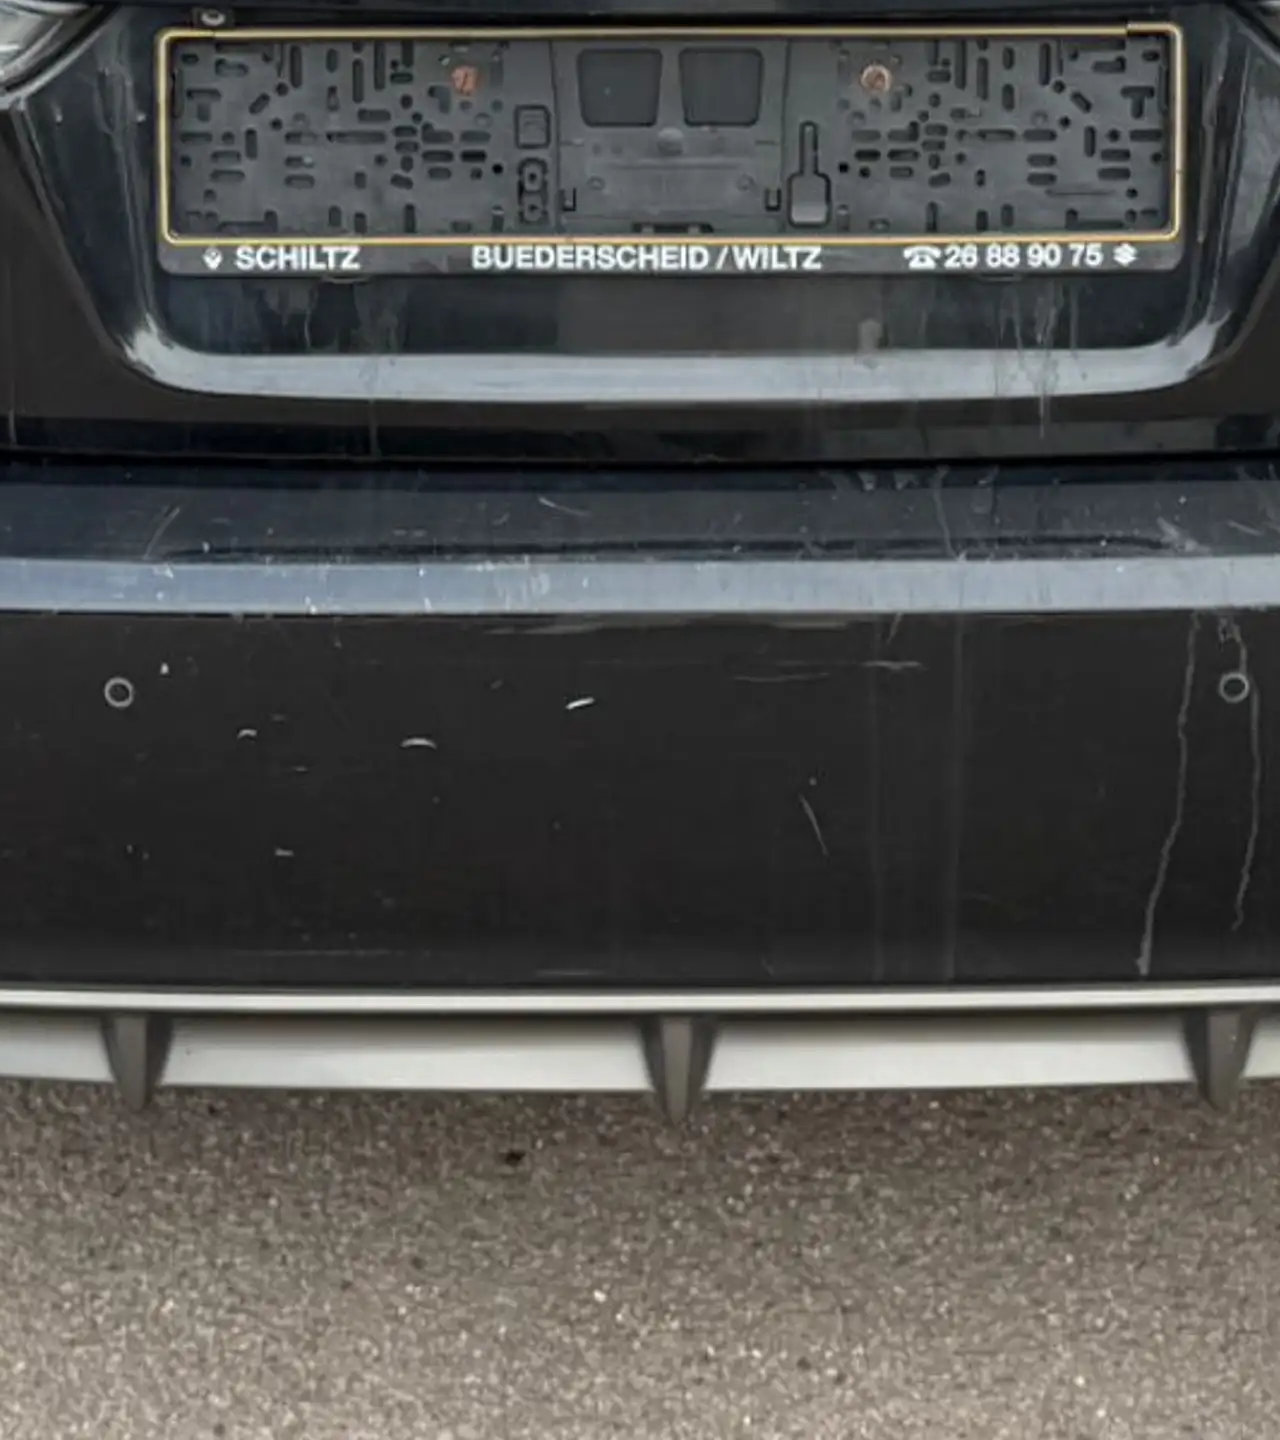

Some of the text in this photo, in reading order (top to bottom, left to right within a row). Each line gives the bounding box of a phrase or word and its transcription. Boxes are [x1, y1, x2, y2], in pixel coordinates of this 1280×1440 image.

[234, 245, 362, 271] SCHILTZ
[471, 244, 710, 271] BUEDERSCHEID
[943, 243, 1104, 269] 26 88 90 75
